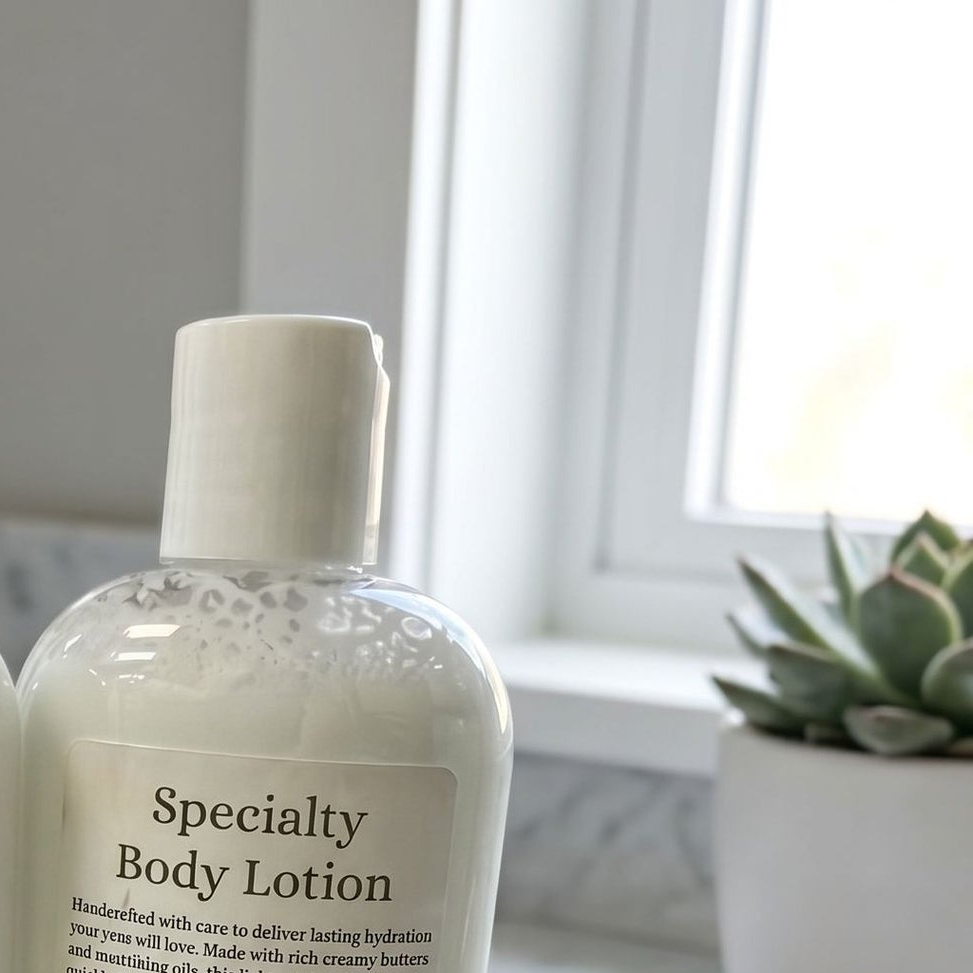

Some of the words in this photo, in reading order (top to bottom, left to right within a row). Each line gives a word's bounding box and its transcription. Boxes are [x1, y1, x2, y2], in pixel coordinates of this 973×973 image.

[153, 786, 368, 849] Specialty
[116, 843, 230, 901] Body
[243, 860, 392, 901] Lotion
[68, 944, 91, 959] and
[69, 922, 99, 936] your
[136, 935, 160, 950] will
[165, 937, 198, 955] love.
[203, 943, 246, 960] Made
[250, 948, 283, 963] with
[288, 950, 318, 965] rich
[323, 953, 377, 970] creamy
[381, 952, 429, 967] butters
[159, 915, 191, 931] with
[196, 922, 228, 935] care
[232, 924, 248, 937] to
[252, 924, 306, 942] deliver
[310, 928, 361, 948] lasting
[364, 928, 432, 948] hydration
